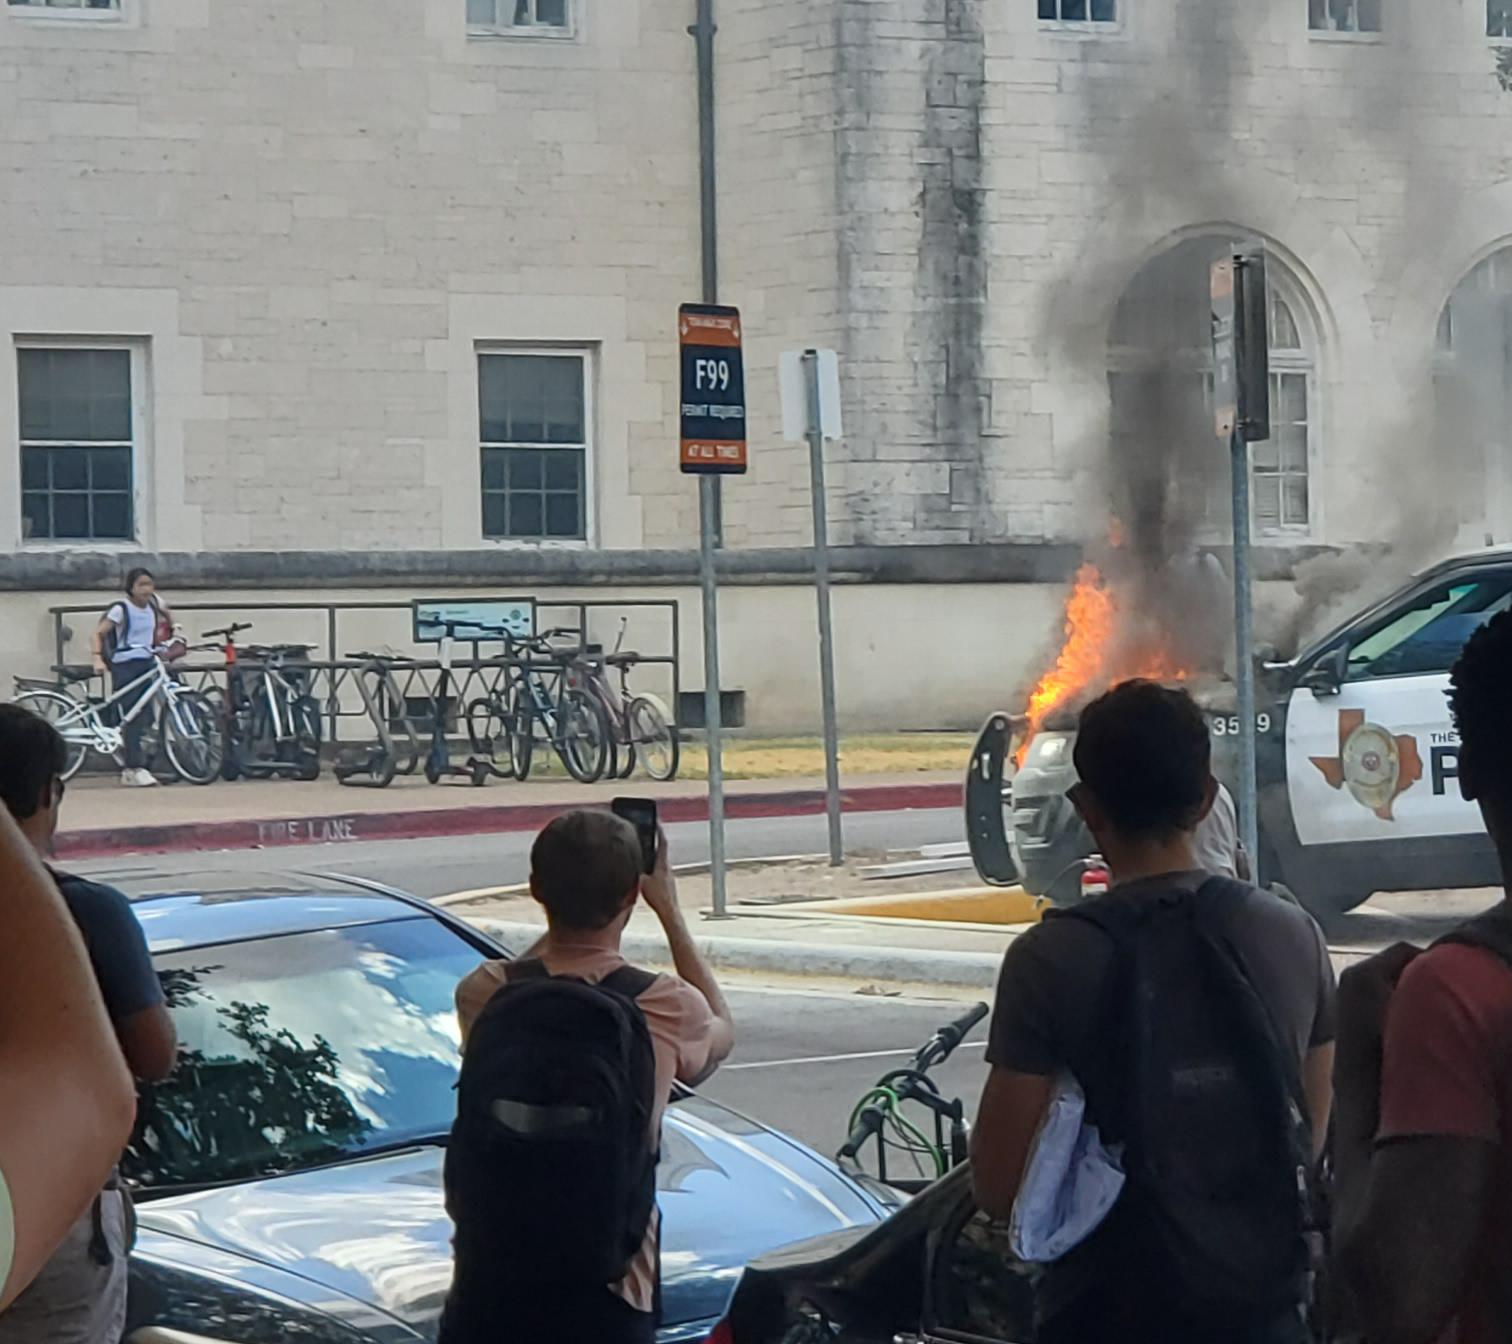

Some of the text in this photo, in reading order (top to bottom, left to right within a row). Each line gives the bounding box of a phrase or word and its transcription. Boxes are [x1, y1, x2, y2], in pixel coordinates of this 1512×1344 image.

[696, 359, 729, 390] F99
[1213, 713, 1270, 736] 359
[1430, 732, 1456, 743] THE
[307, 819, 358, 840] LANE
